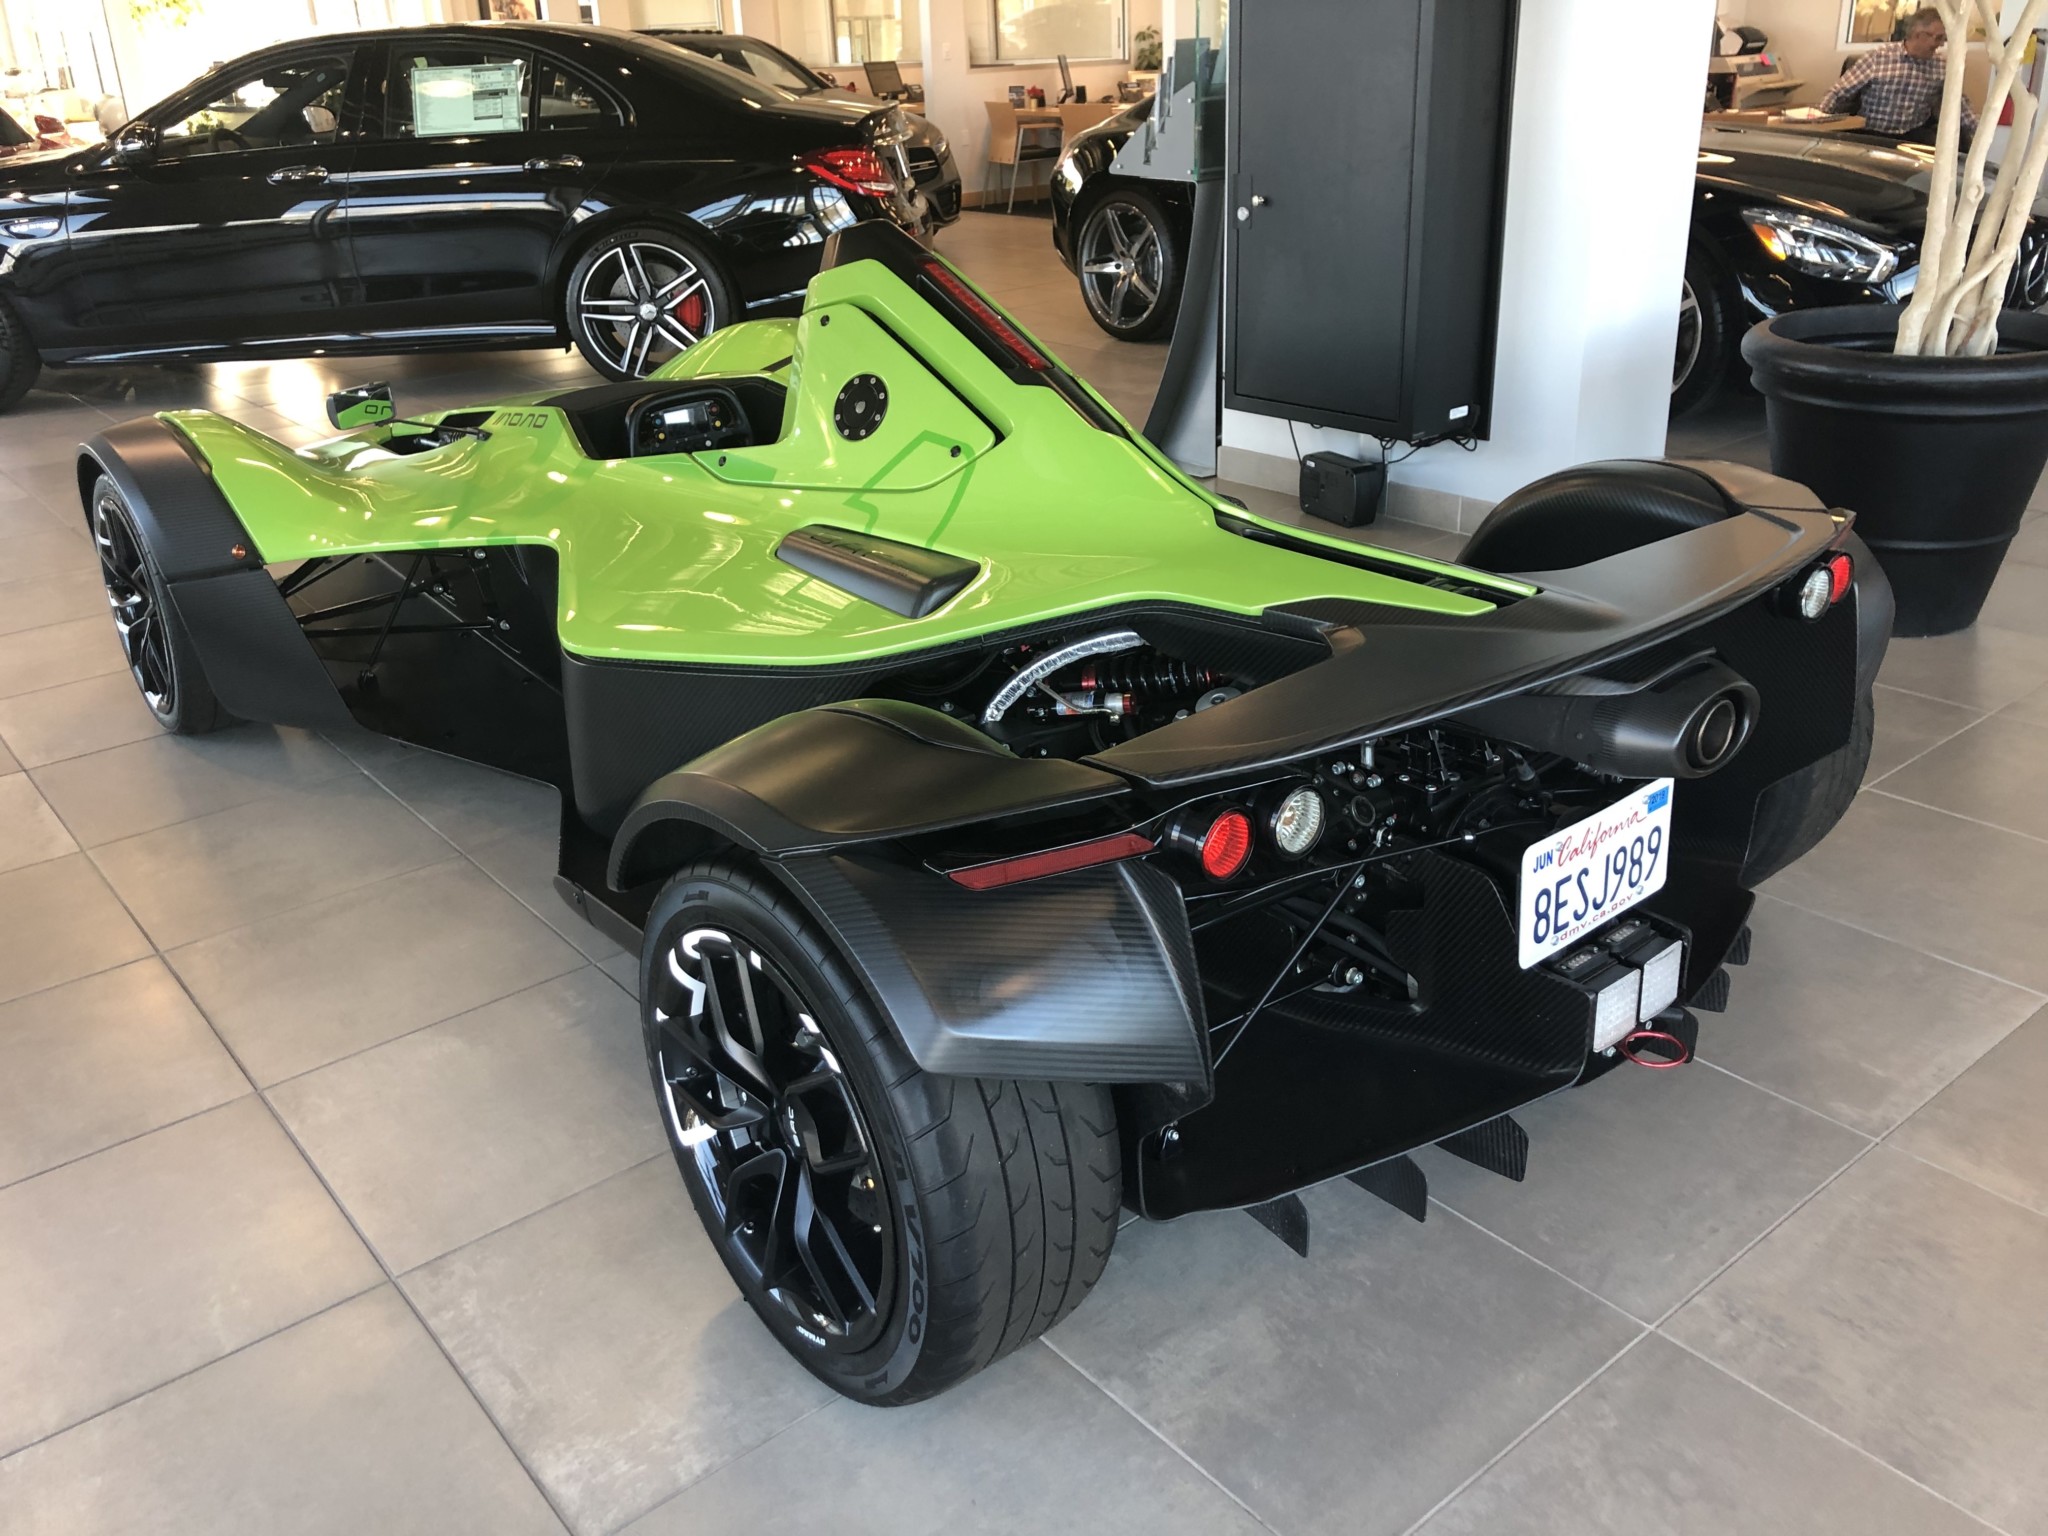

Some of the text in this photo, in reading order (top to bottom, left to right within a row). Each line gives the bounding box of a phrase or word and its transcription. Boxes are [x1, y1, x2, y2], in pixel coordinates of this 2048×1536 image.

[1533, 808, 1647, 873] JUN California
[1533, 825, 1662, 944] 8ESJ989
[1560, 893, 1634, 941] dmv.ca.gov
